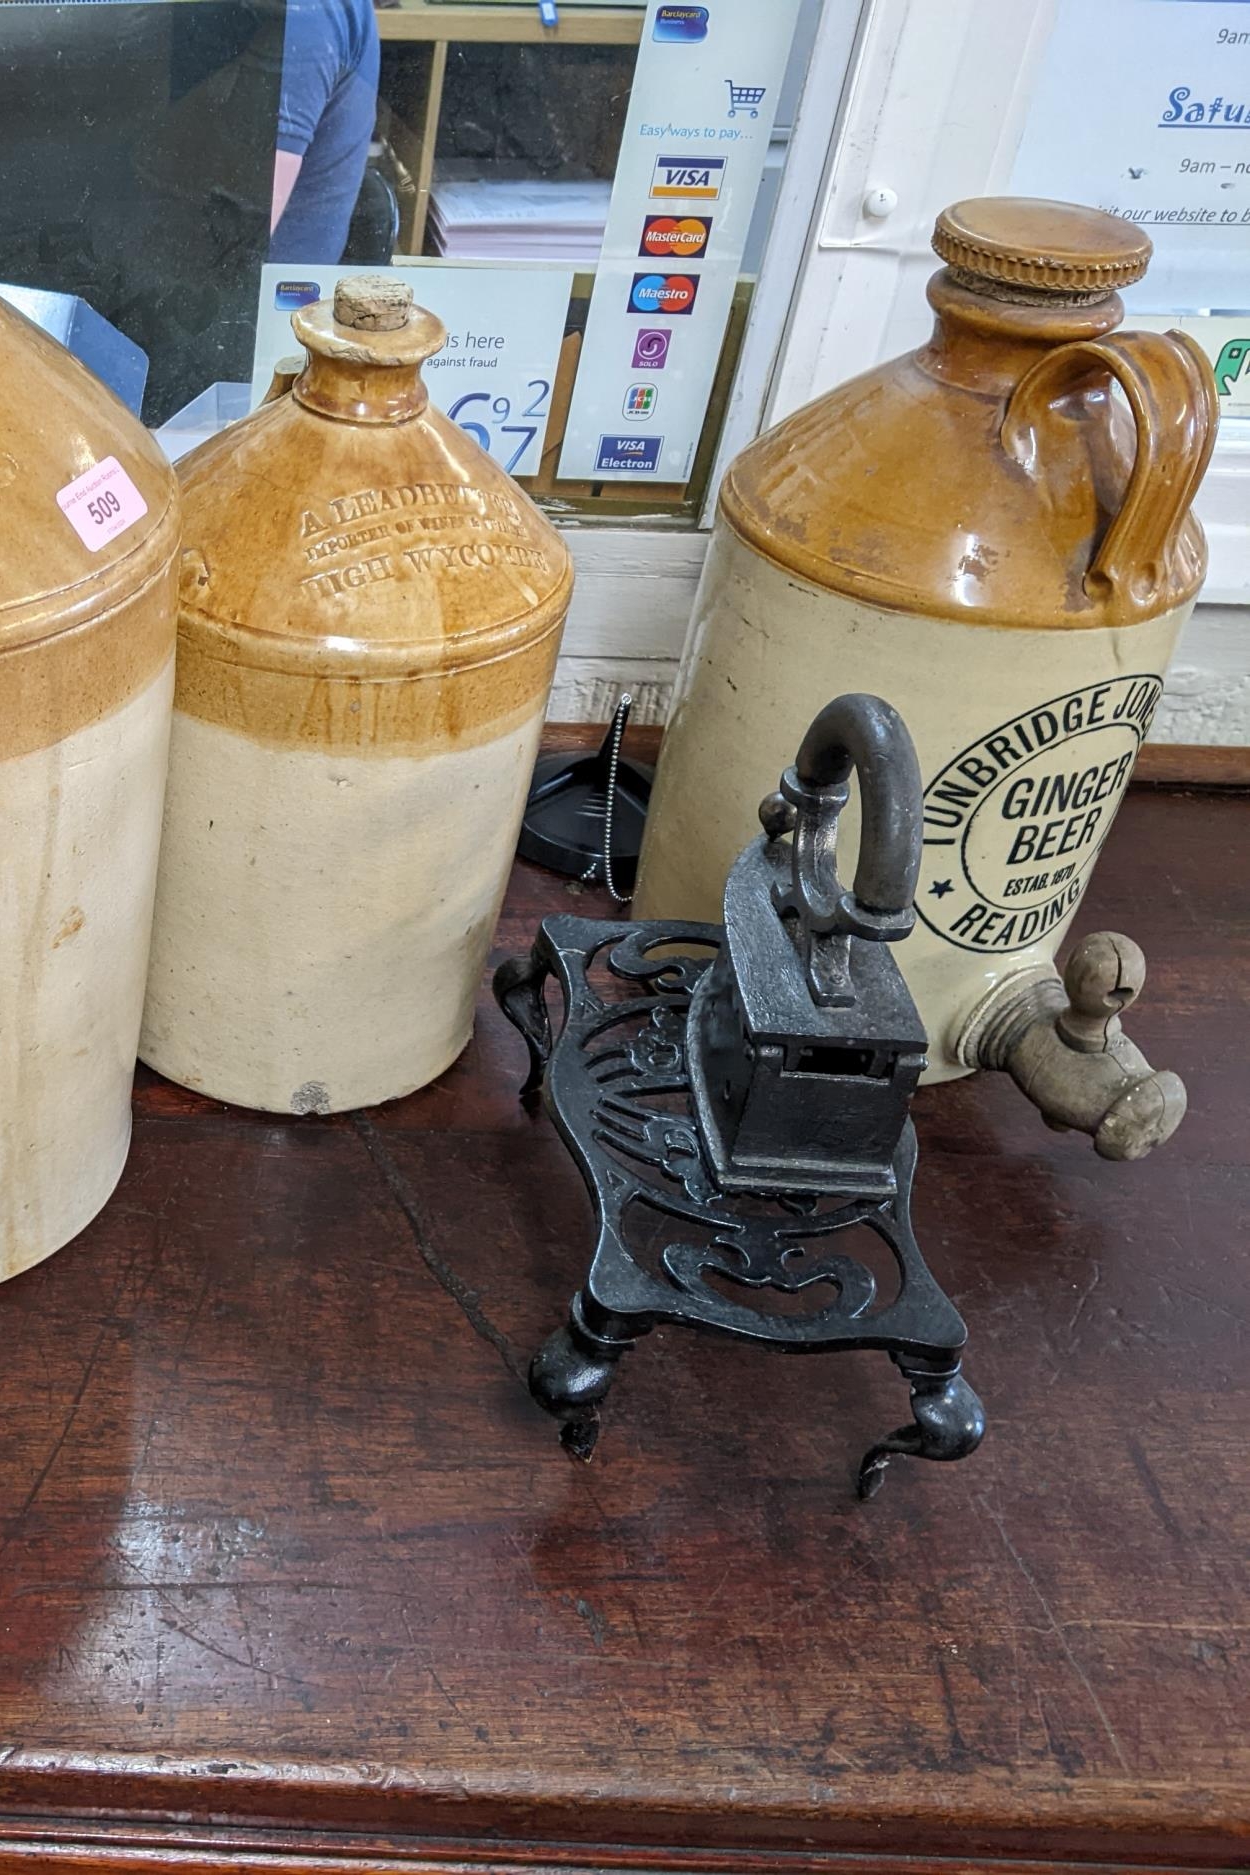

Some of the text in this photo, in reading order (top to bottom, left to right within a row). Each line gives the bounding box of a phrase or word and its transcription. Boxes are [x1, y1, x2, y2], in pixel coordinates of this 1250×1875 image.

[661, 9, 702, 19] Barclaycard
[639, 123, 668, 138] Easy
[669, 127, 701, 140] ways
[703, 126, 716, 139] to
[1178, 158, 1216, 174] 9am
[665, 169, 711, 187] VISA
[1121, 208, 1152, 221] our
[1154, 207, 1217, 223] website
[1220, 208, 1238, 223] to
[645, 230, 706, 244] MasterCard
[638, 287, 689, 300] Maestro
[465, 331, 505, 349] here
[427, 356, 498, 370] against fraud
[616, 439, 646, 451] VISA
[600, 457, 653, 469] Electron
[87, 490, 121, 525] 509
[298, 554, 396, 599] HIGH
[1001, 750, 1133, 820] GINGER
[1005, 806, 1103, 866] BEER
[1002, 862, 1077, 898] ESTAB. 1870
[949, 877, 1080, 947] READING
